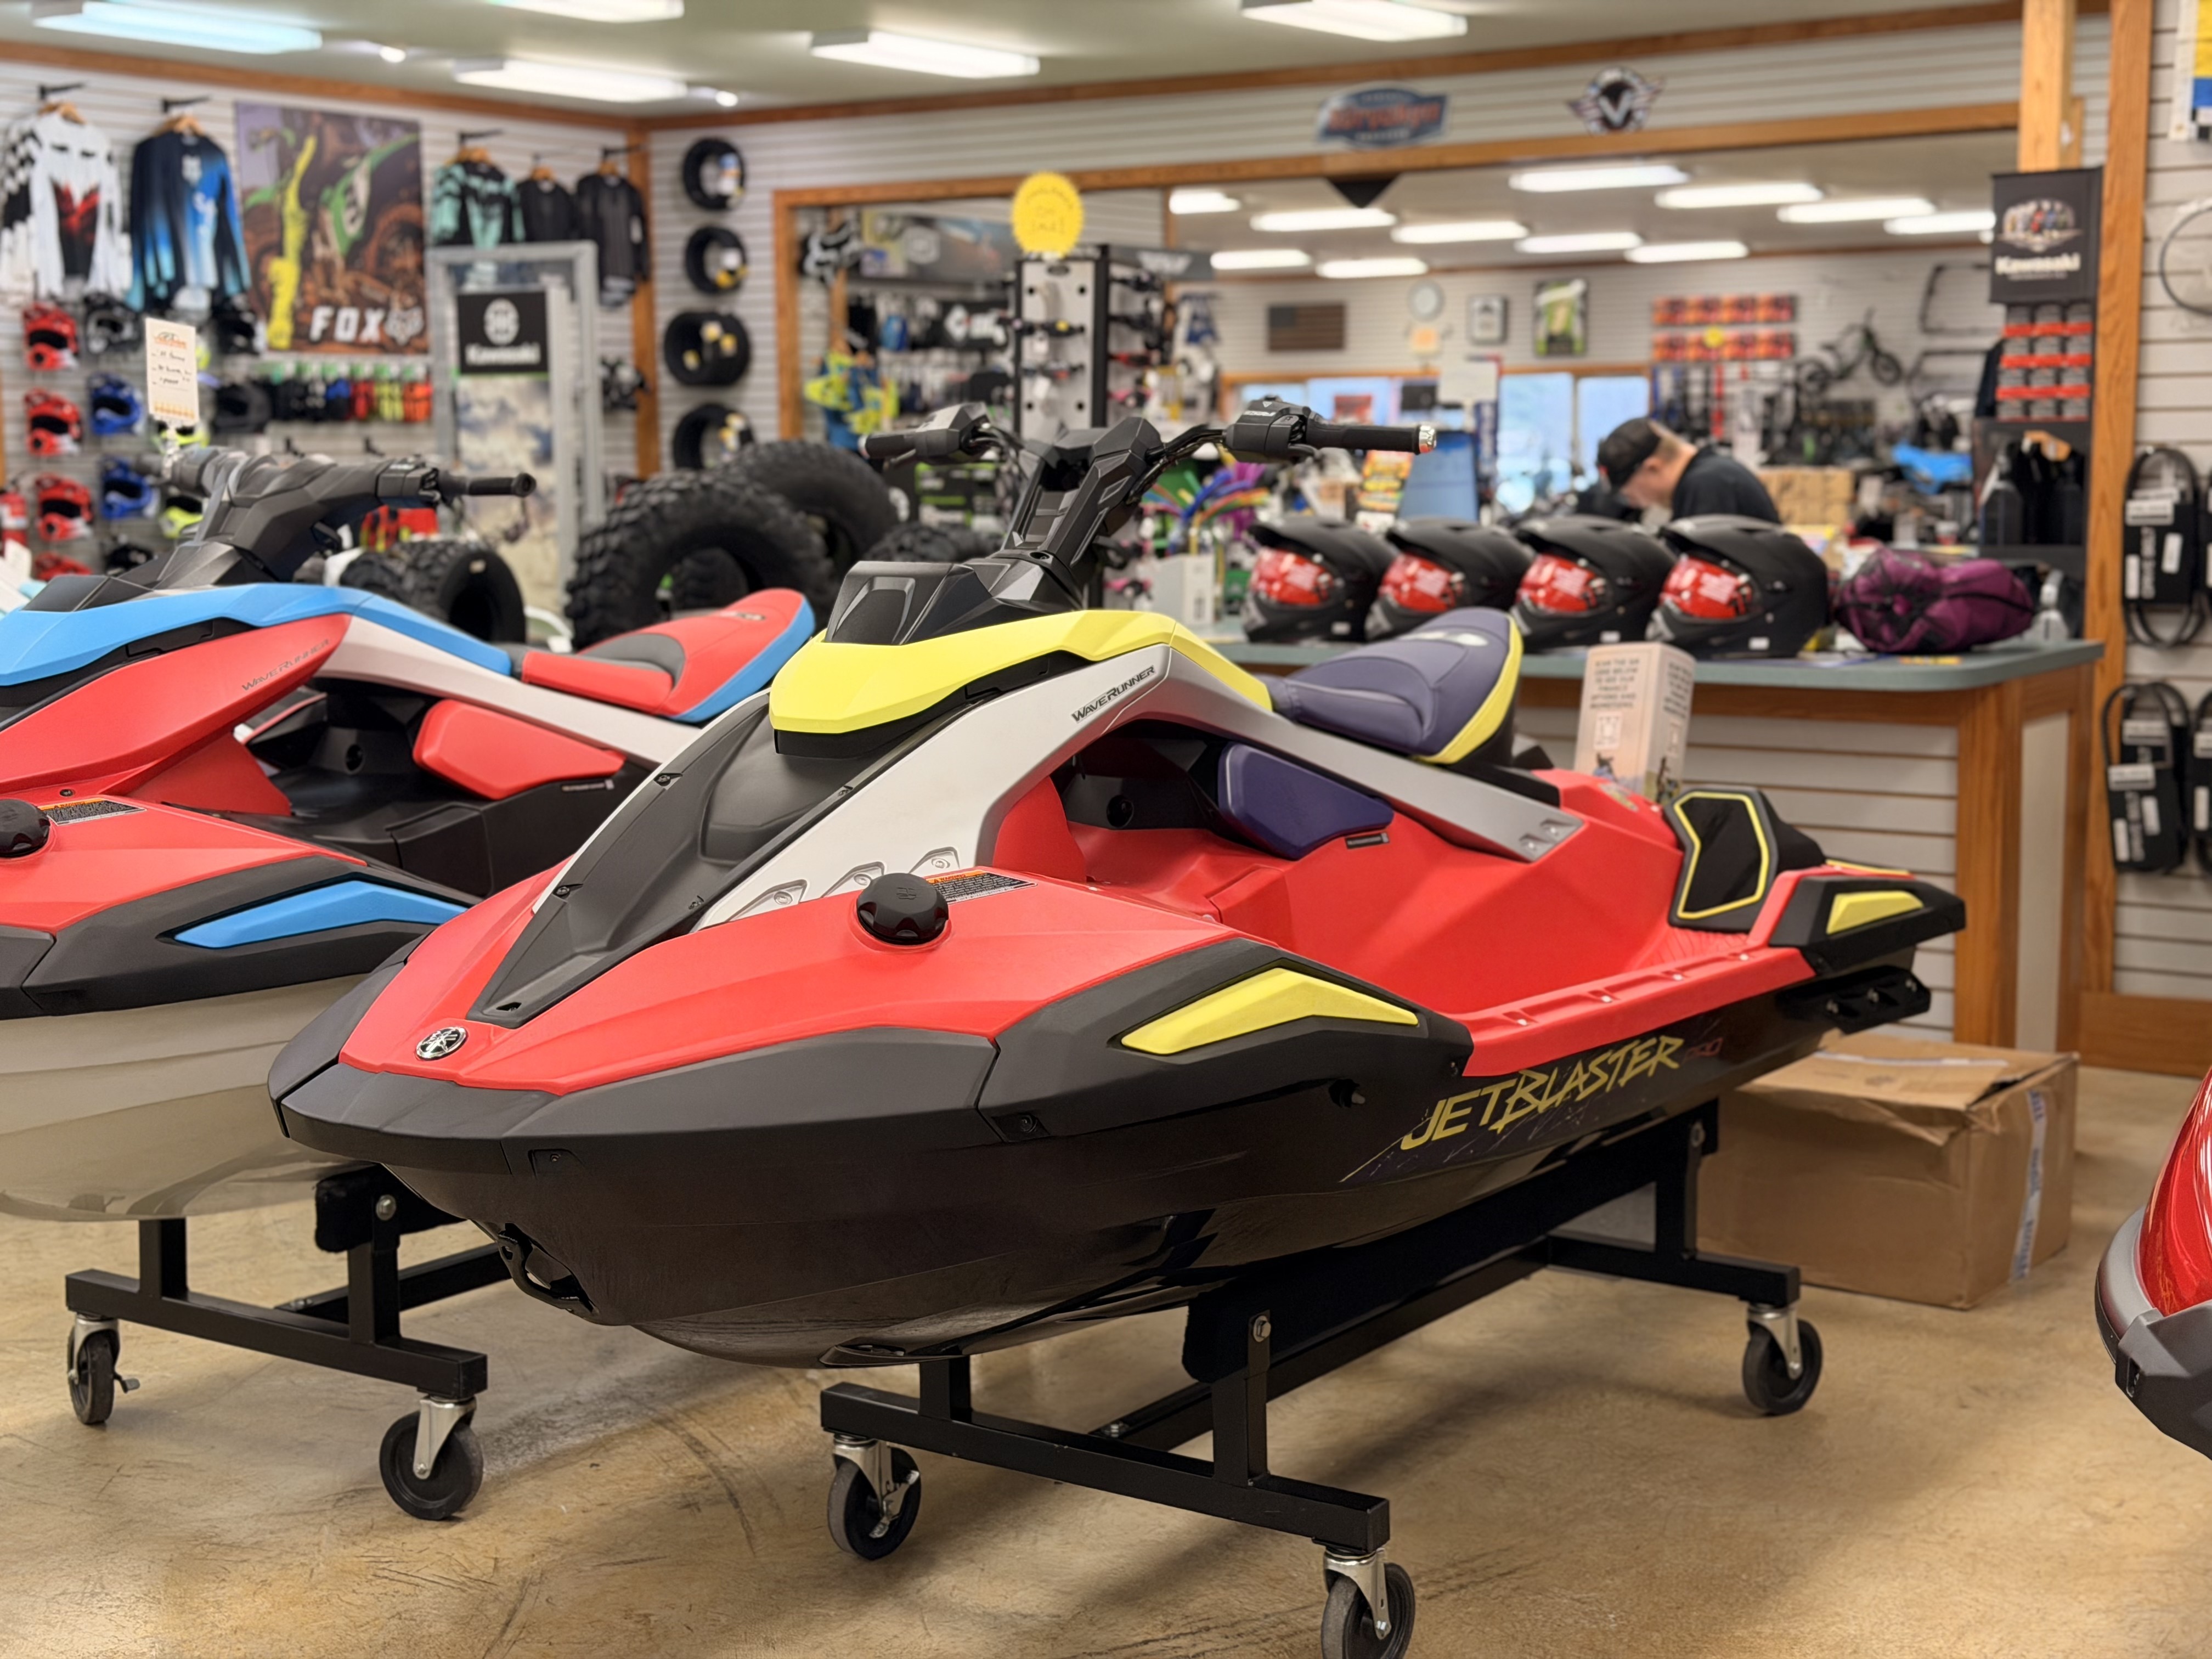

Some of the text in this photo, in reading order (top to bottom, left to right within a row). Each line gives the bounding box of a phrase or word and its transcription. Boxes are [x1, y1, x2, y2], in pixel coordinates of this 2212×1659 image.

[1995, 252, 2081, 275] Kawasaki
[309, 305, 385, 343] FOX
[465, 342, 541, 366] Kawasaki
[1070, 664, 1155, 723] WAVERUNNER
[1400, 1035, 1684, 1150] JETBLASTER
